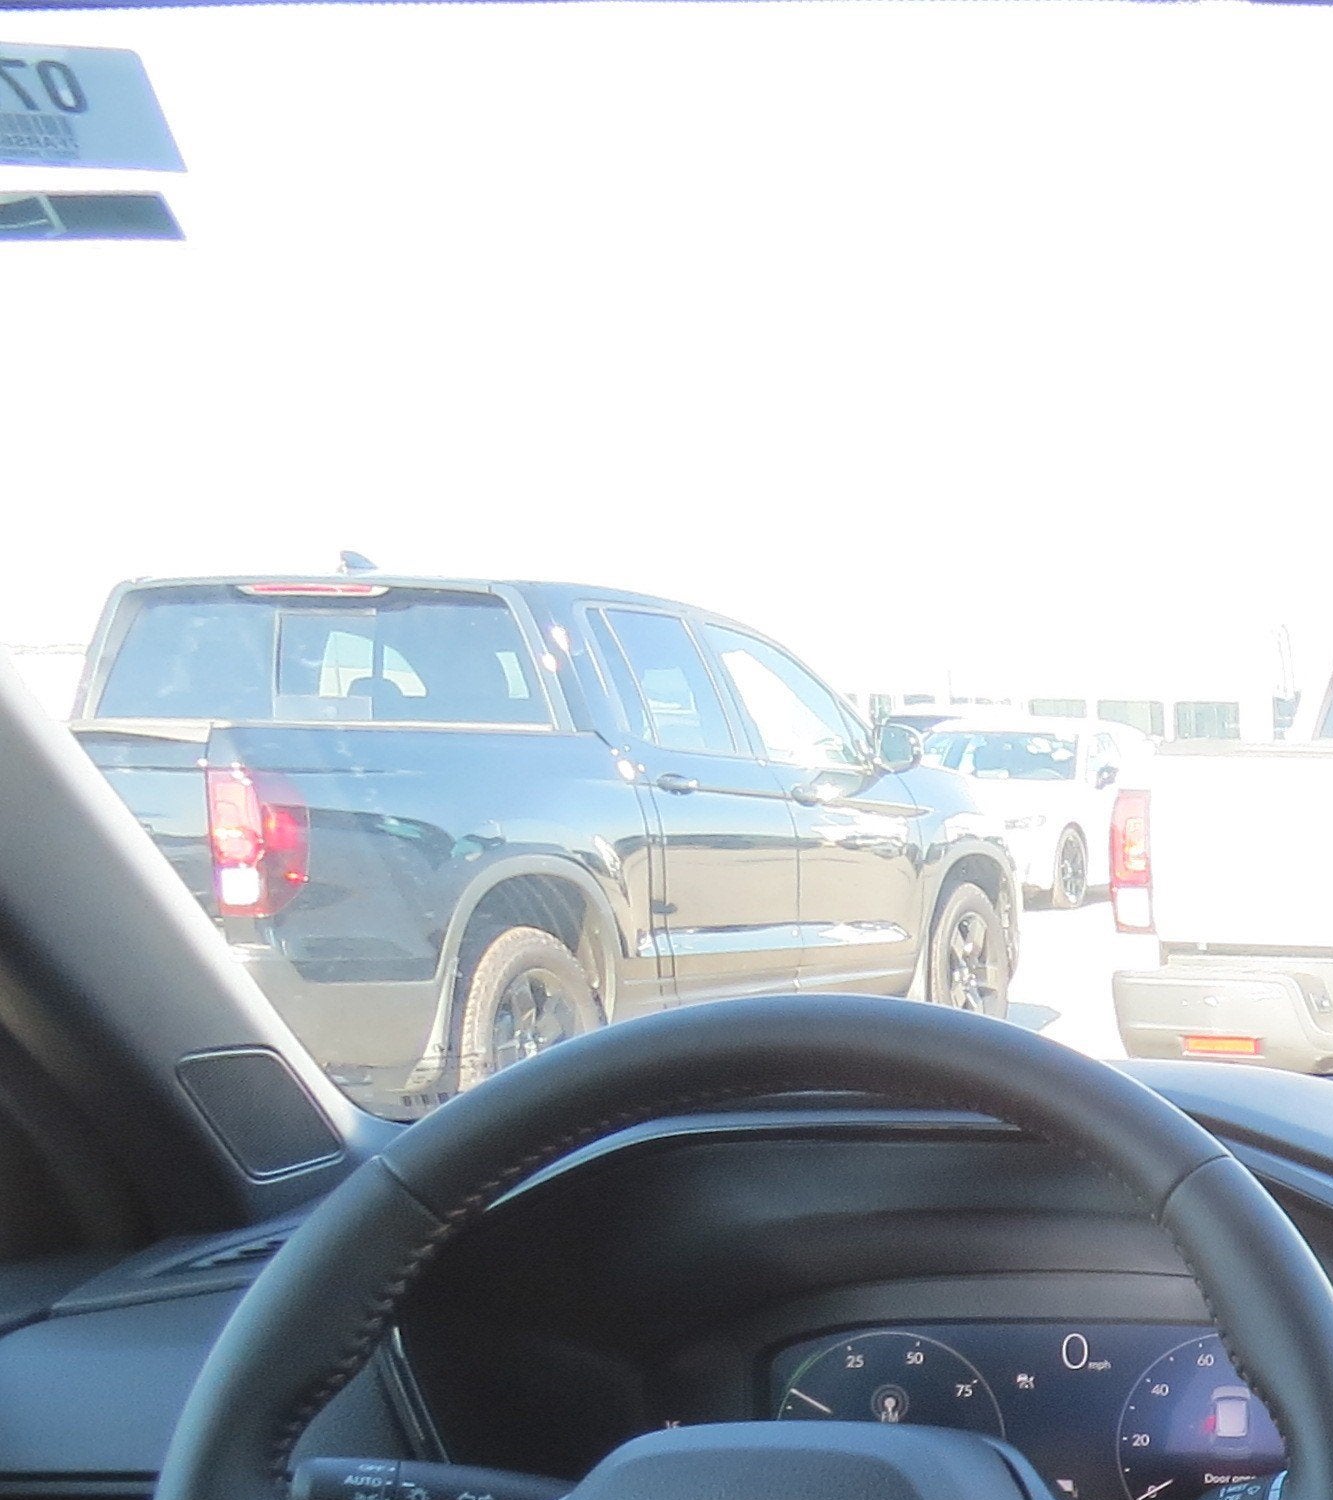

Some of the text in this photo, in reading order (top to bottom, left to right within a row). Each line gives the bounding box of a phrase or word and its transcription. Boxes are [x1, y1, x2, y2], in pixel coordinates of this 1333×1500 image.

[1062, 1332, 1088, 1370] 0
[846, 1354, 865, 1368] 25
[906, 1352, 924, 1365] 50
[1197, 1354, 1214, 1366] 60
[955, 1384, 973, 1398] 75
[1151, 1384, 1169, 1396] 40
[1132, 1434, 1150, 1447] 20
[344, 1475, 383, 1487] AUTO
[1204, 1473, 1231, 1484] Door
